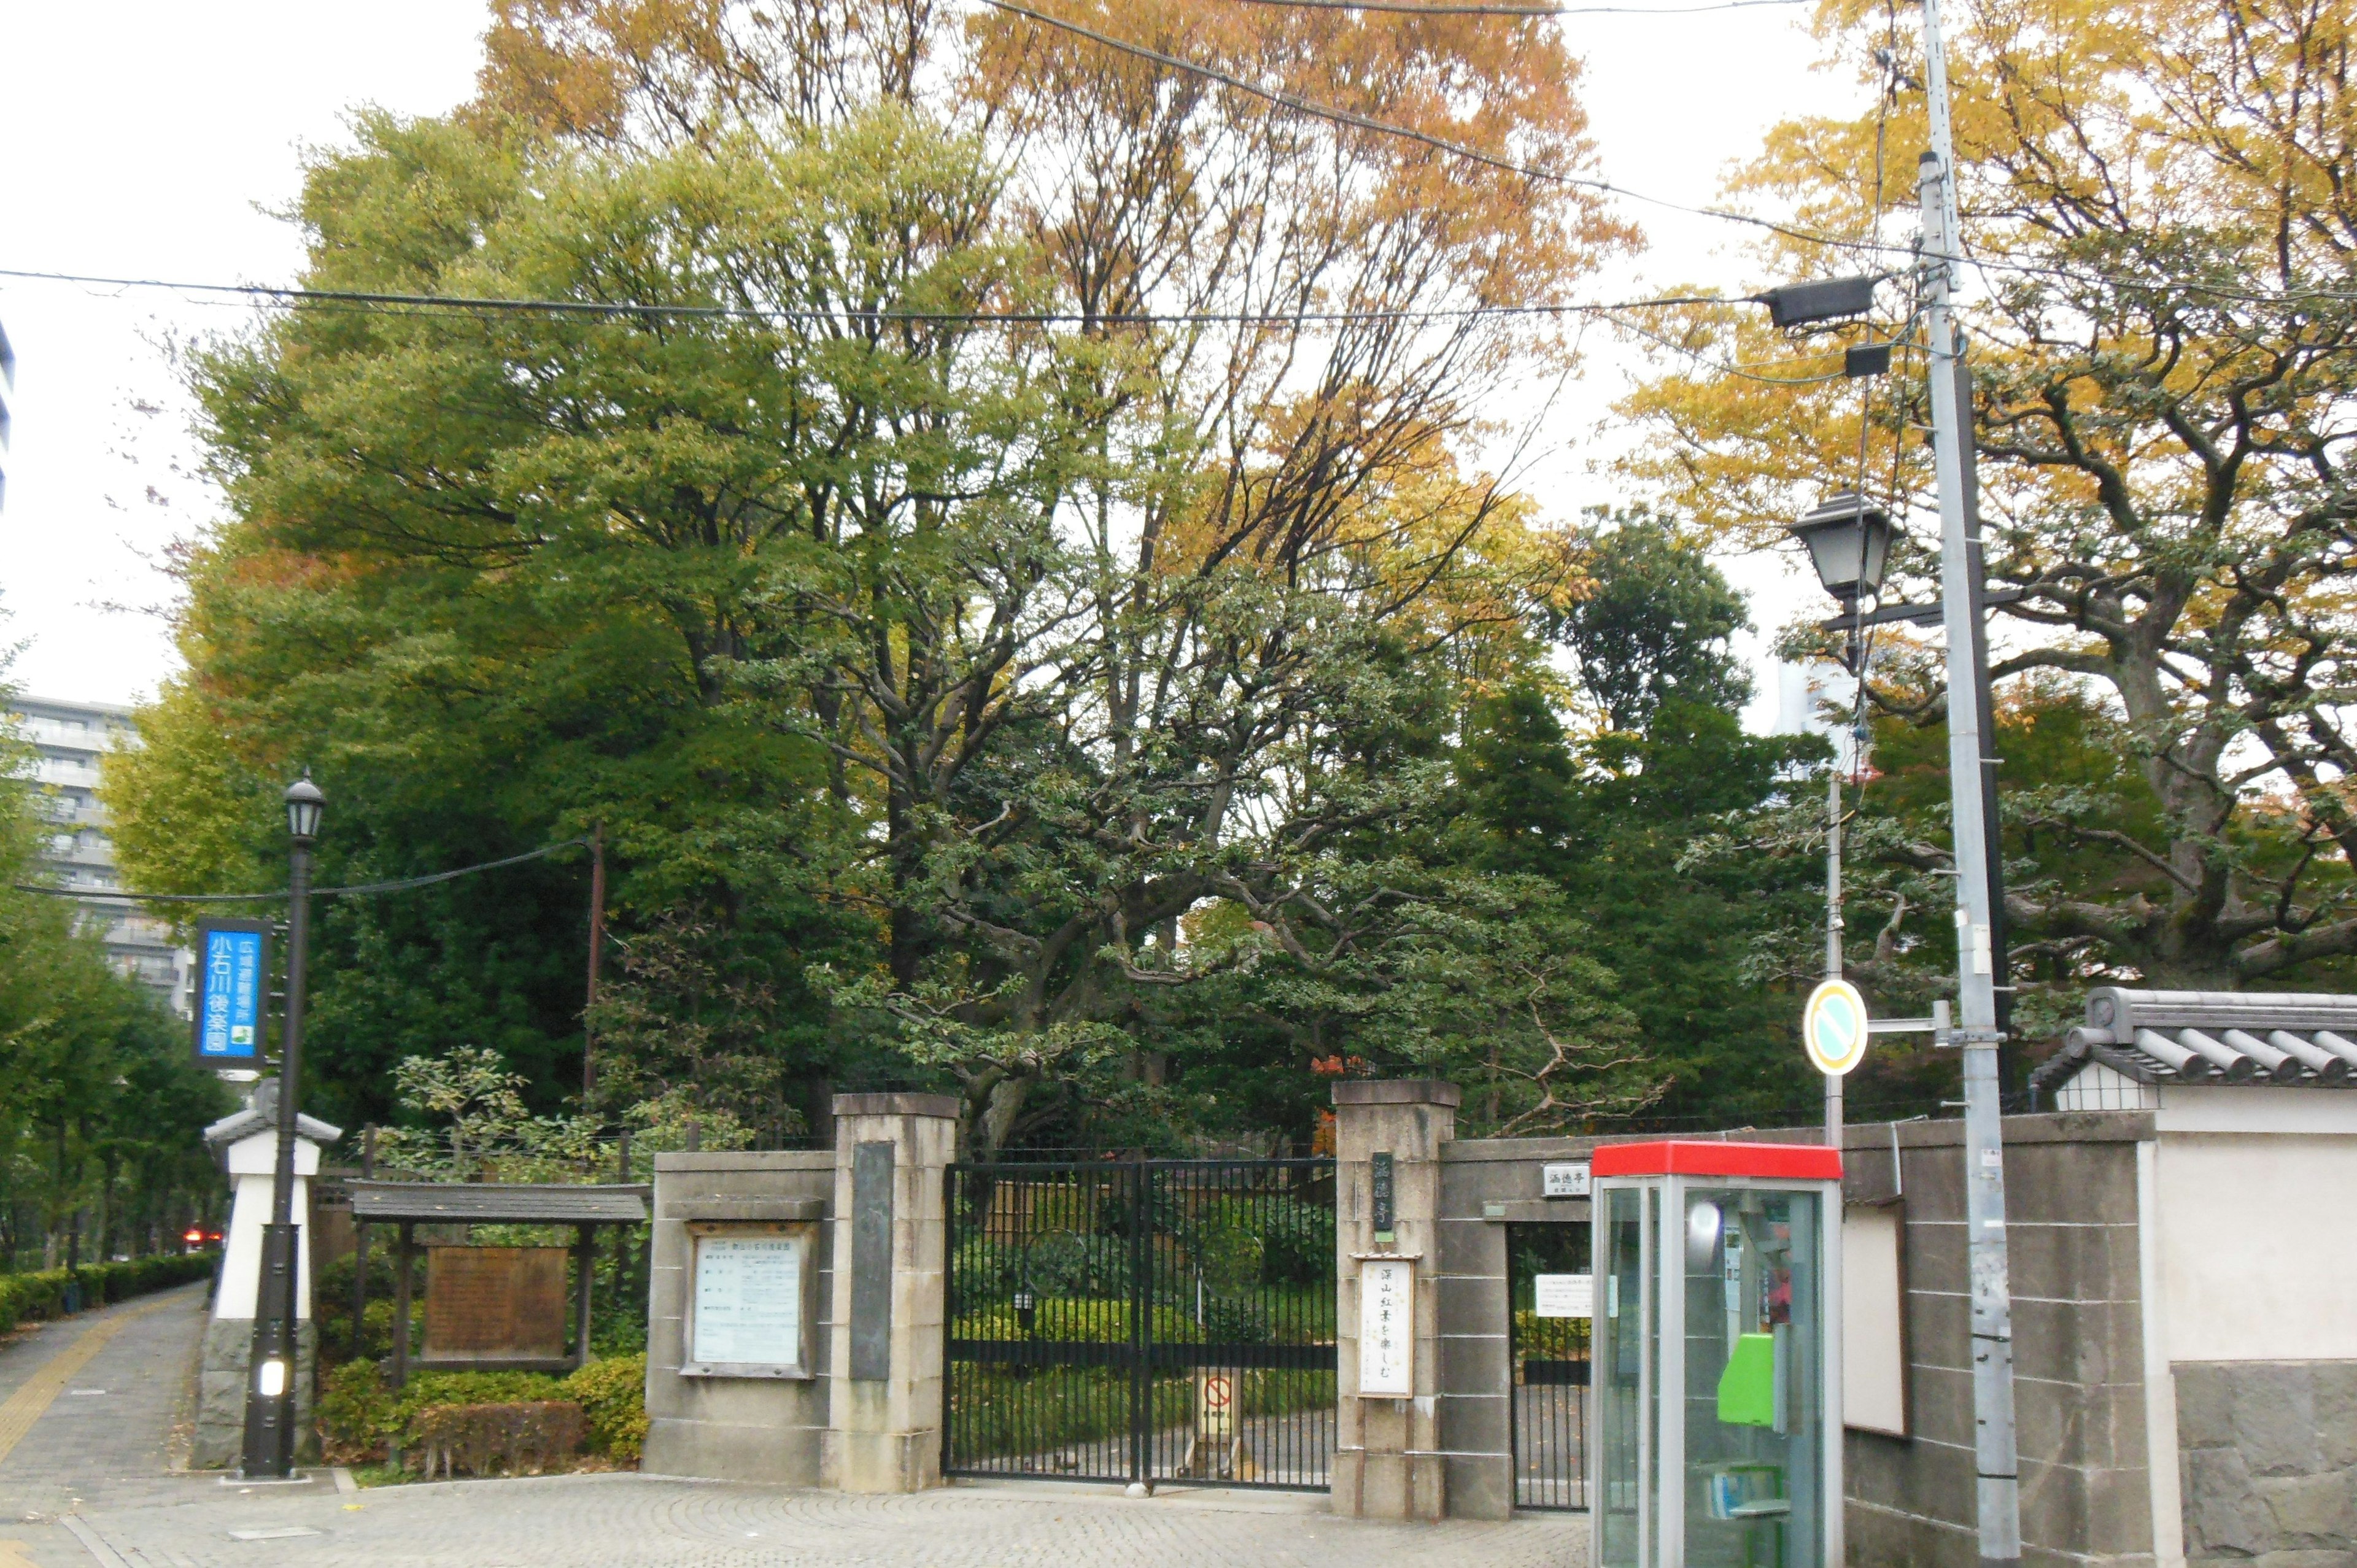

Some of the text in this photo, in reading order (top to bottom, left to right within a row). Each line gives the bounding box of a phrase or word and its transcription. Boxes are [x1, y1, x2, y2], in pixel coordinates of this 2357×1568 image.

[206, 937, 232, 1051] 小石川後楽園
[1380, 1269, 1393, 1378] 深山紅葉を楽しむ
